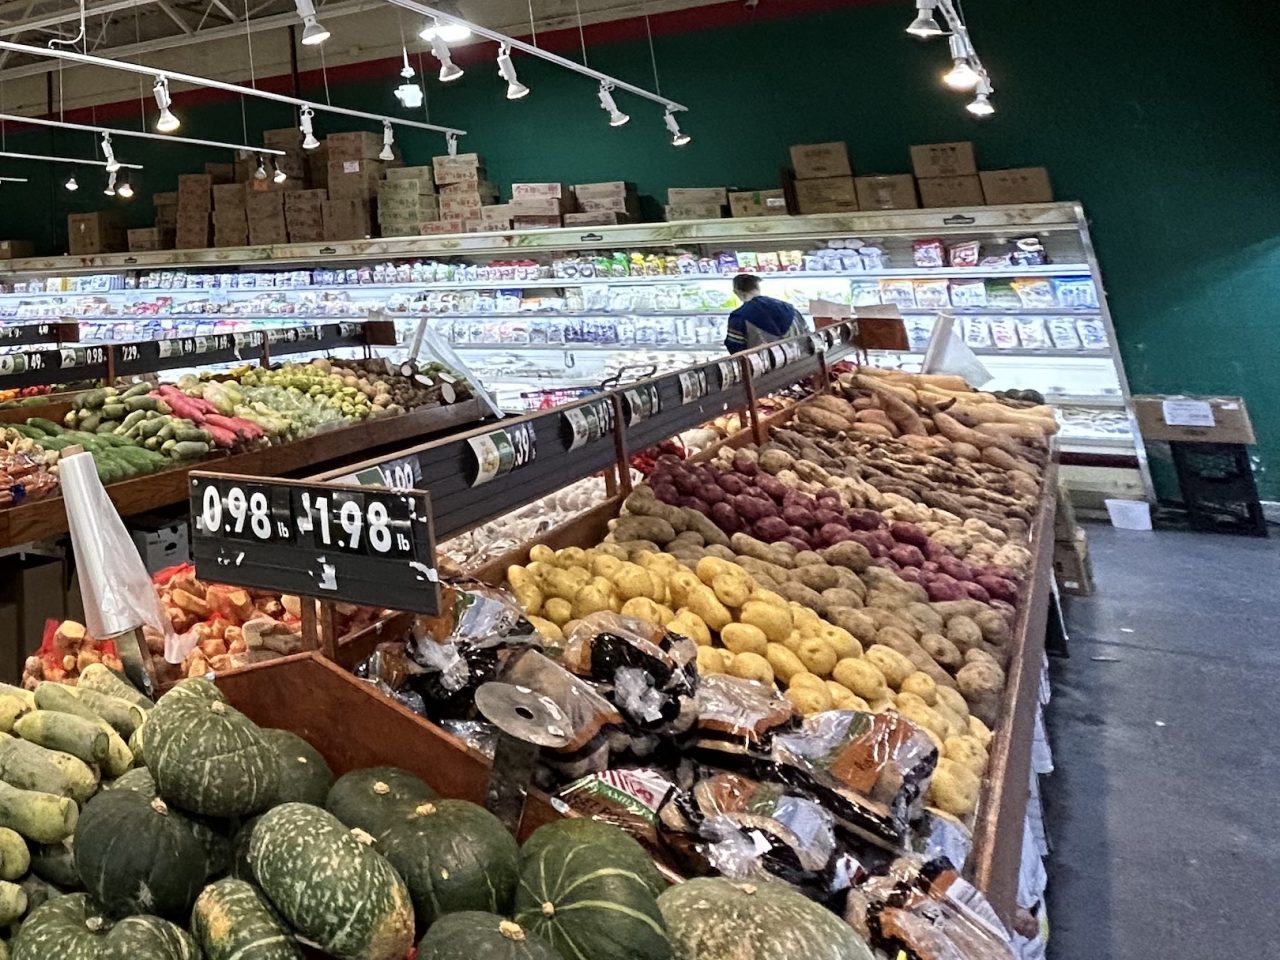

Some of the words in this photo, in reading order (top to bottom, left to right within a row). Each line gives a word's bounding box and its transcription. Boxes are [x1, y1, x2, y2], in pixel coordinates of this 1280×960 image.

[202, 485, 272, 539] 0.98
[277, 521, 290, 538] lb
[315, 496, 392, 553] 1.98
[397, 533, 410, 552] lb
